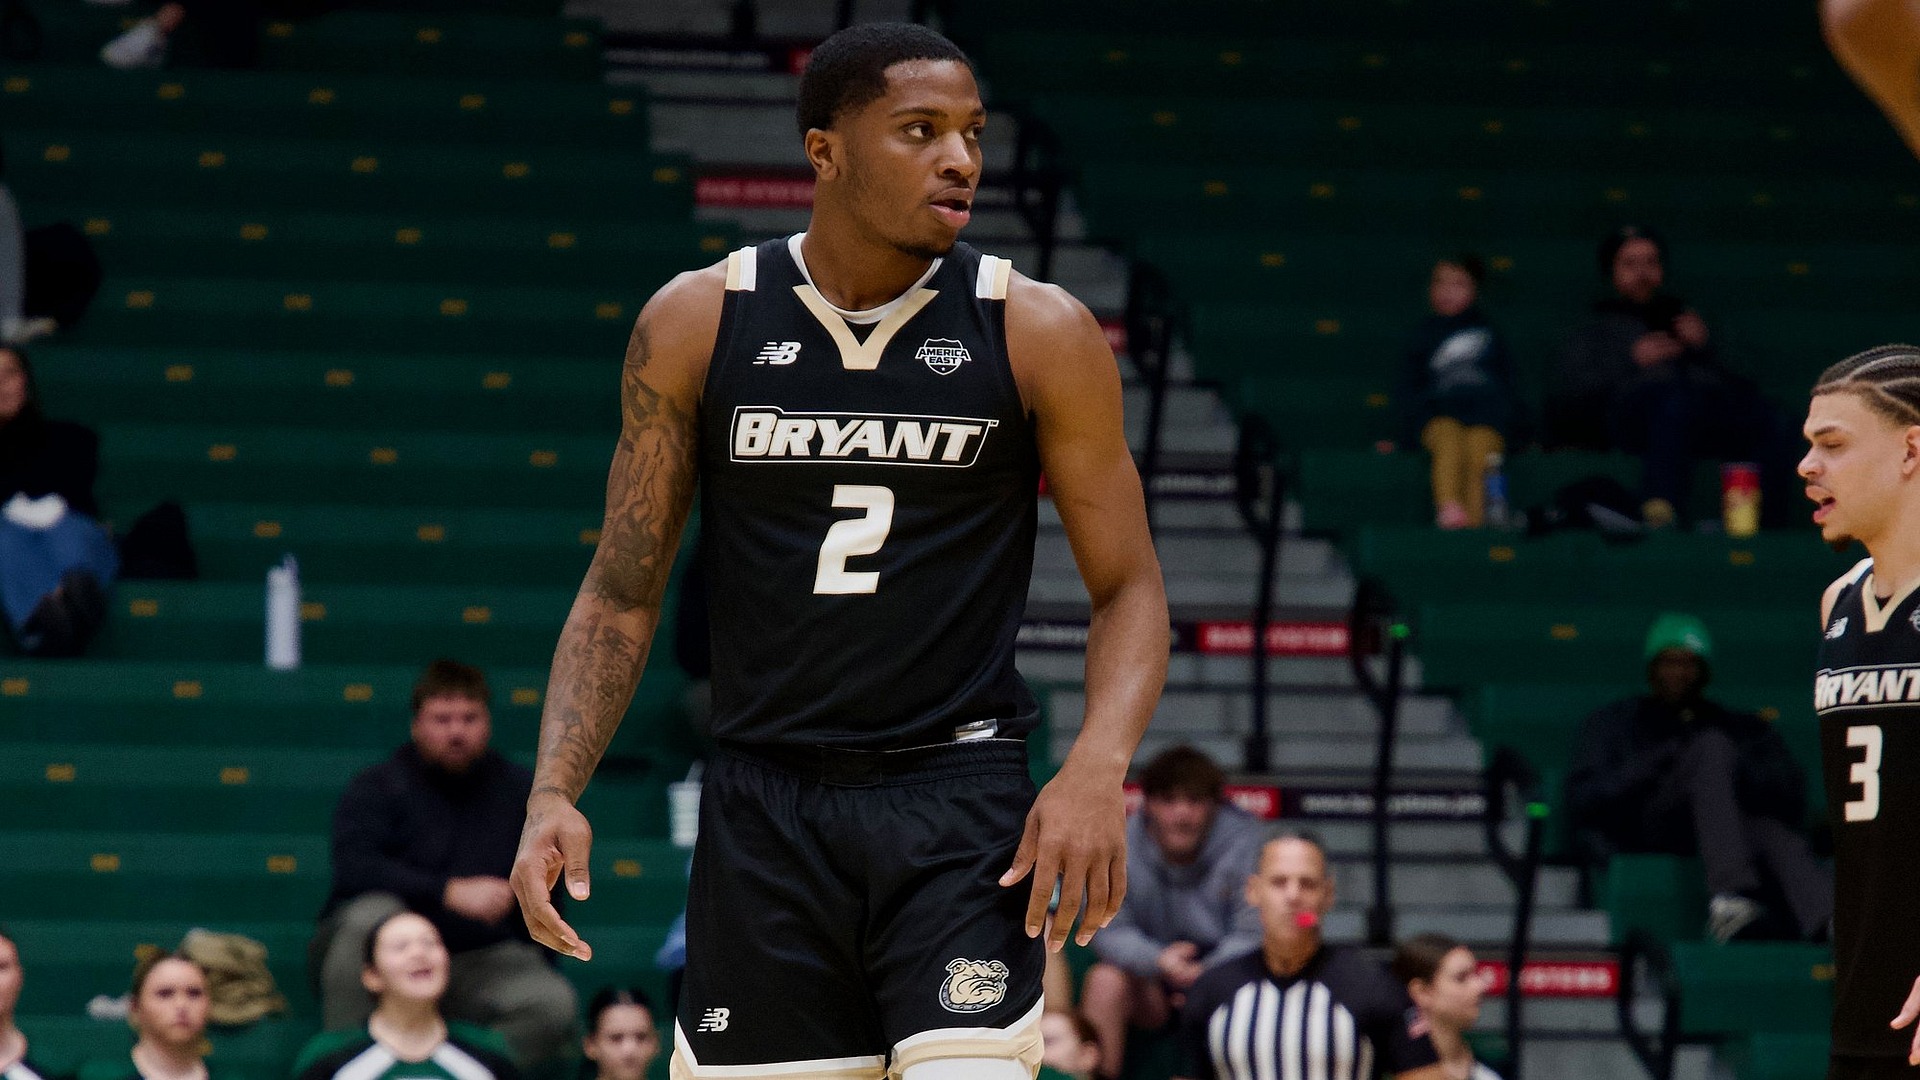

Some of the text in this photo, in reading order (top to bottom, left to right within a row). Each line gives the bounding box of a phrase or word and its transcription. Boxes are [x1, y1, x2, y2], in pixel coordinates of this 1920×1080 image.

[918, 349, 968, 360] AMERICA
[929, 356, 957, 364] EAST
[735, 412, 982, 461] BRYANT
[813, 484, 895, 594] 2
[1845, 725, 1882, 822] 3
